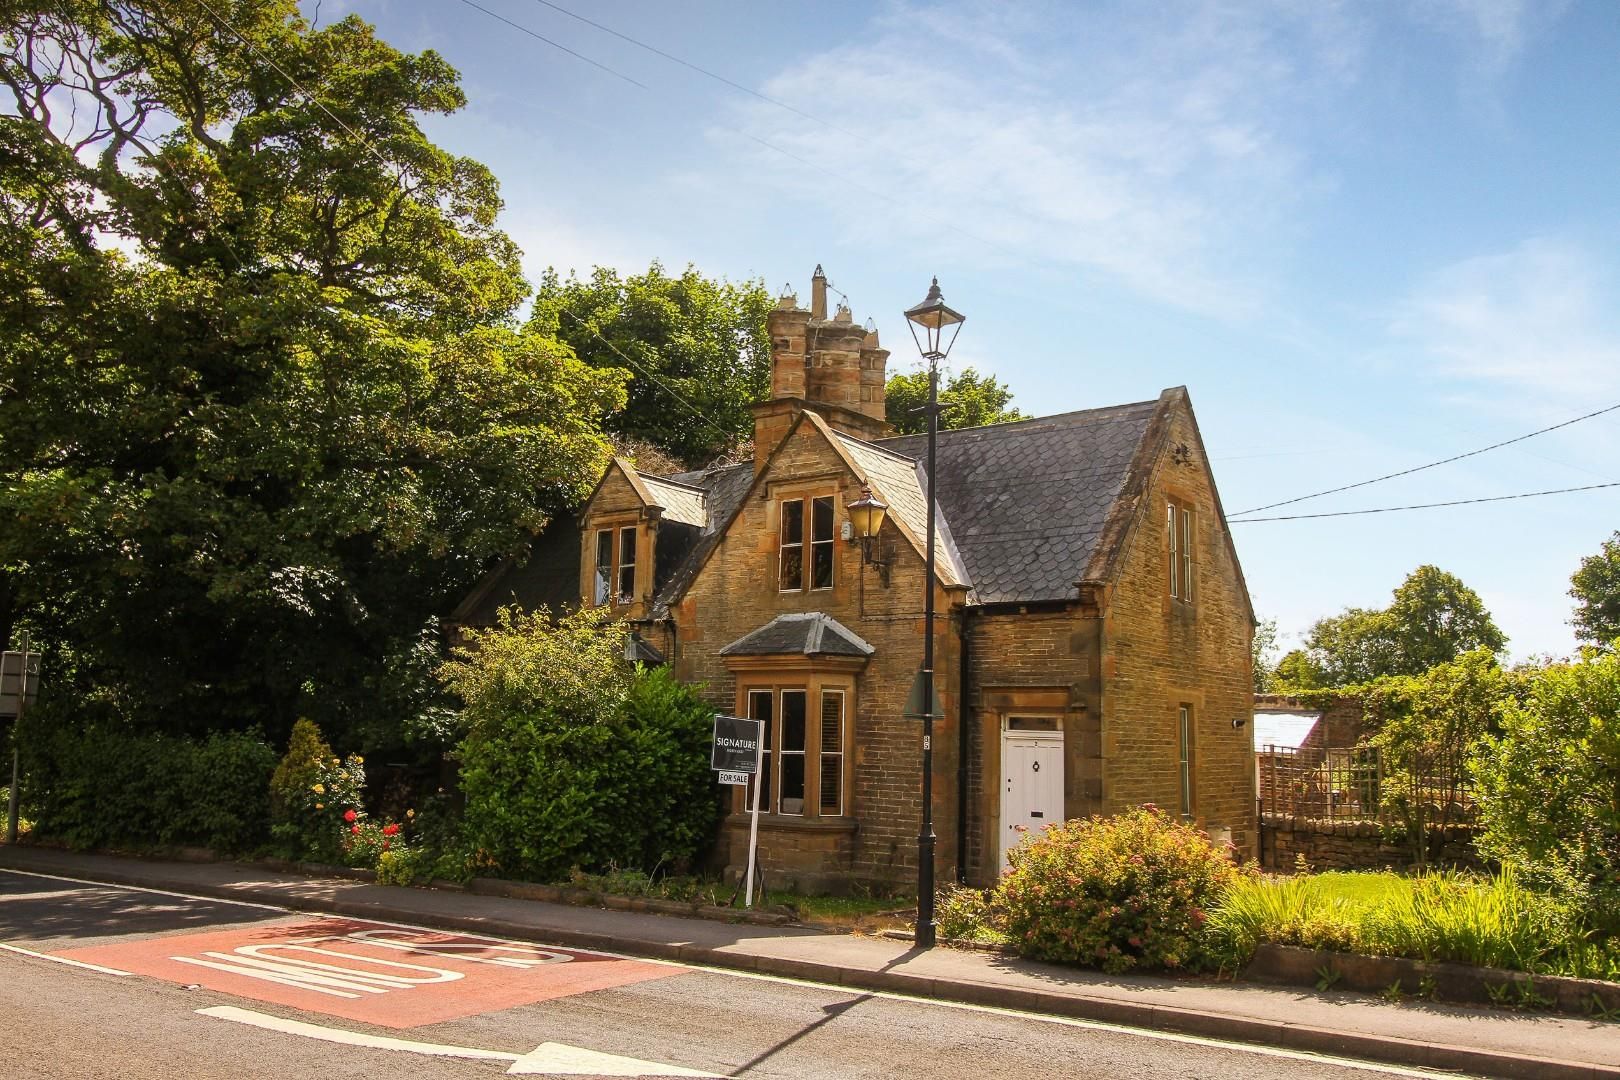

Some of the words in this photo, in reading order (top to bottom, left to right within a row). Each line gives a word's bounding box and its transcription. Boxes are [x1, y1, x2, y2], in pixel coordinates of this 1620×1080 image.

[716, 737, 756, 749] SIGNATURE
[720, 774, 732, 782] FOR
[733, 774, 748, 783] SALE
[169, 929, 575, 999] SLOW
